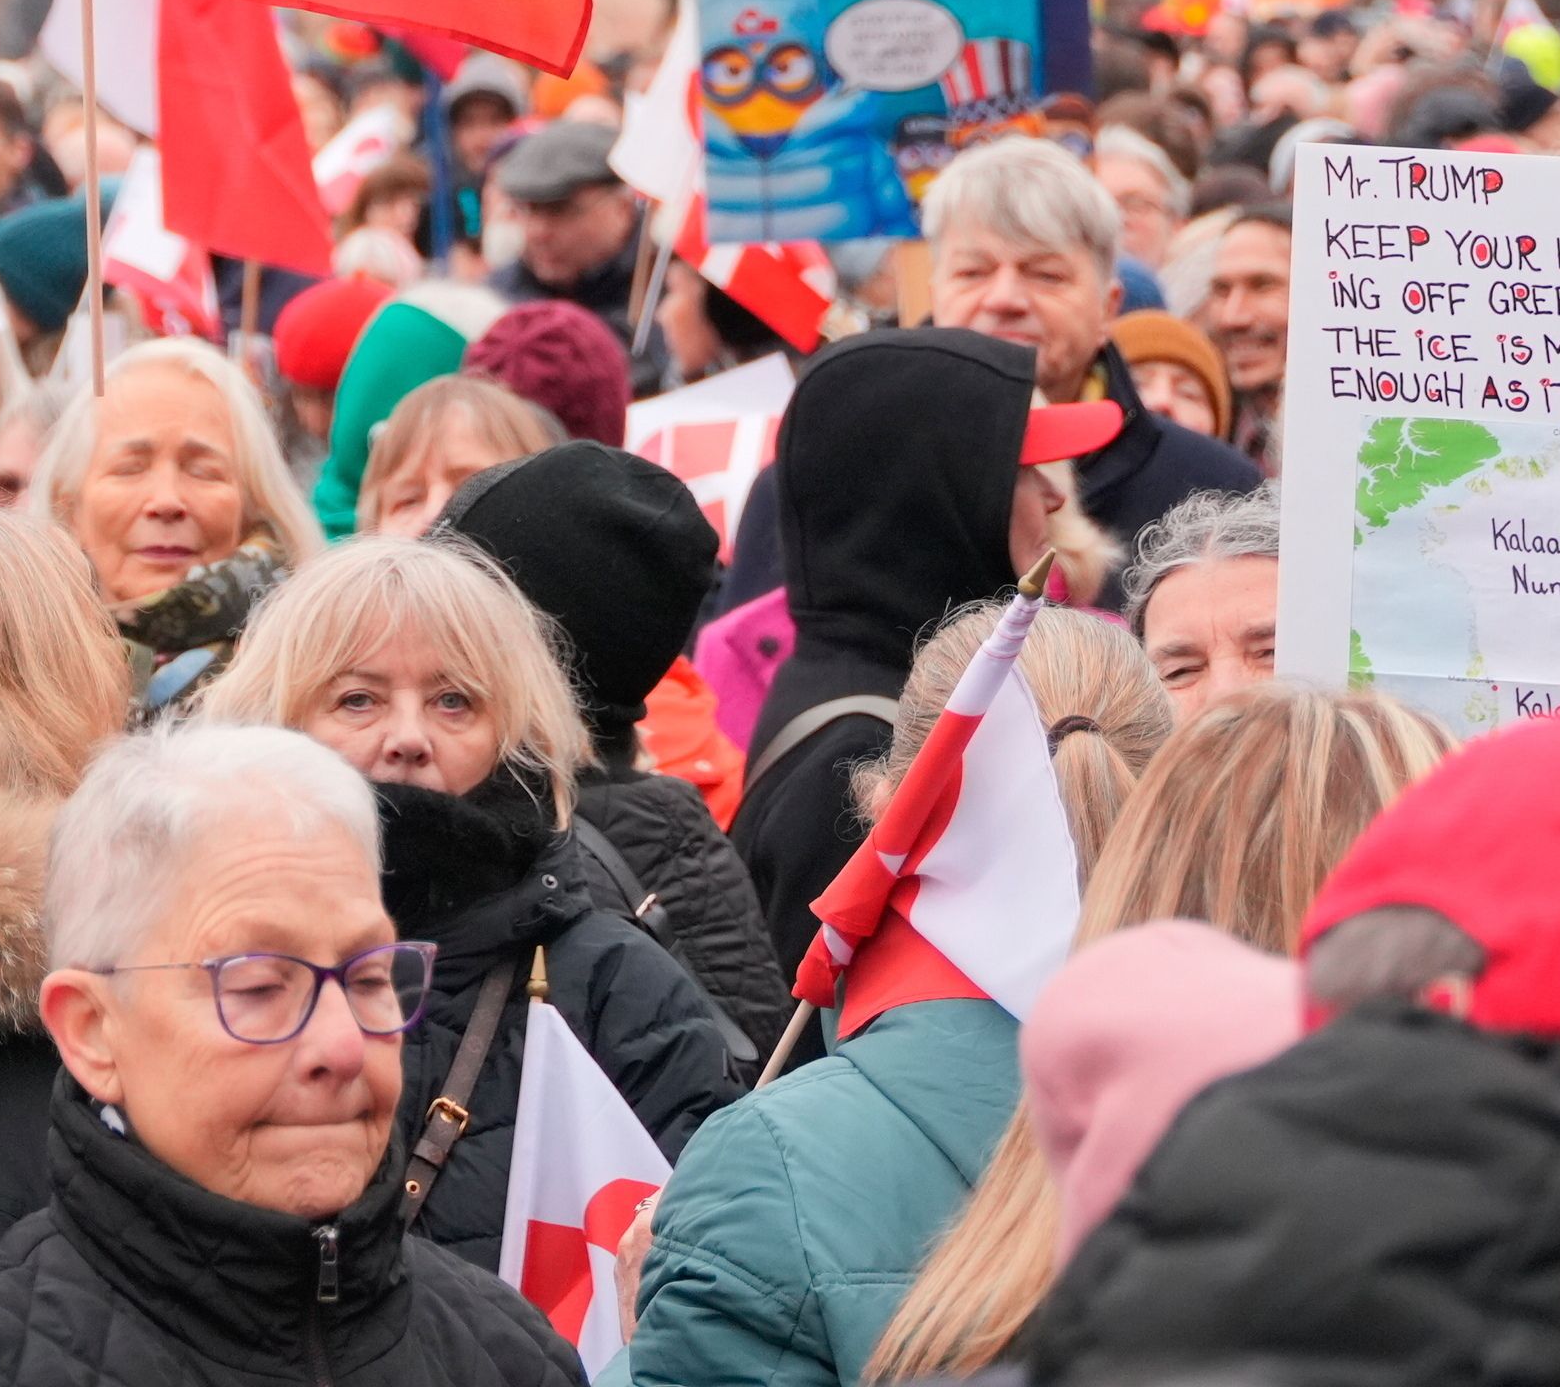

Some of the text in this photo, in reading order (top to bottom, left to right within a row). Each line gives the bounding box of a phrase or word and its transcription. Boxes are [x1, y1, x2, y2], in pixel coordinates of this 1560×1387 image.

[1325, 156, 1503, 205] Mr. TRUMP
[1325, 219, 1430, 262] KEEP
[1445, 229, 1541, 273] YOUR
[1402, 281, 1470, 315] OFF
[1323, 327, 1400, 357] THE
[1331, 367, 1464, 409] ENOUGH
[1481, 375, 1530, 412] AS
